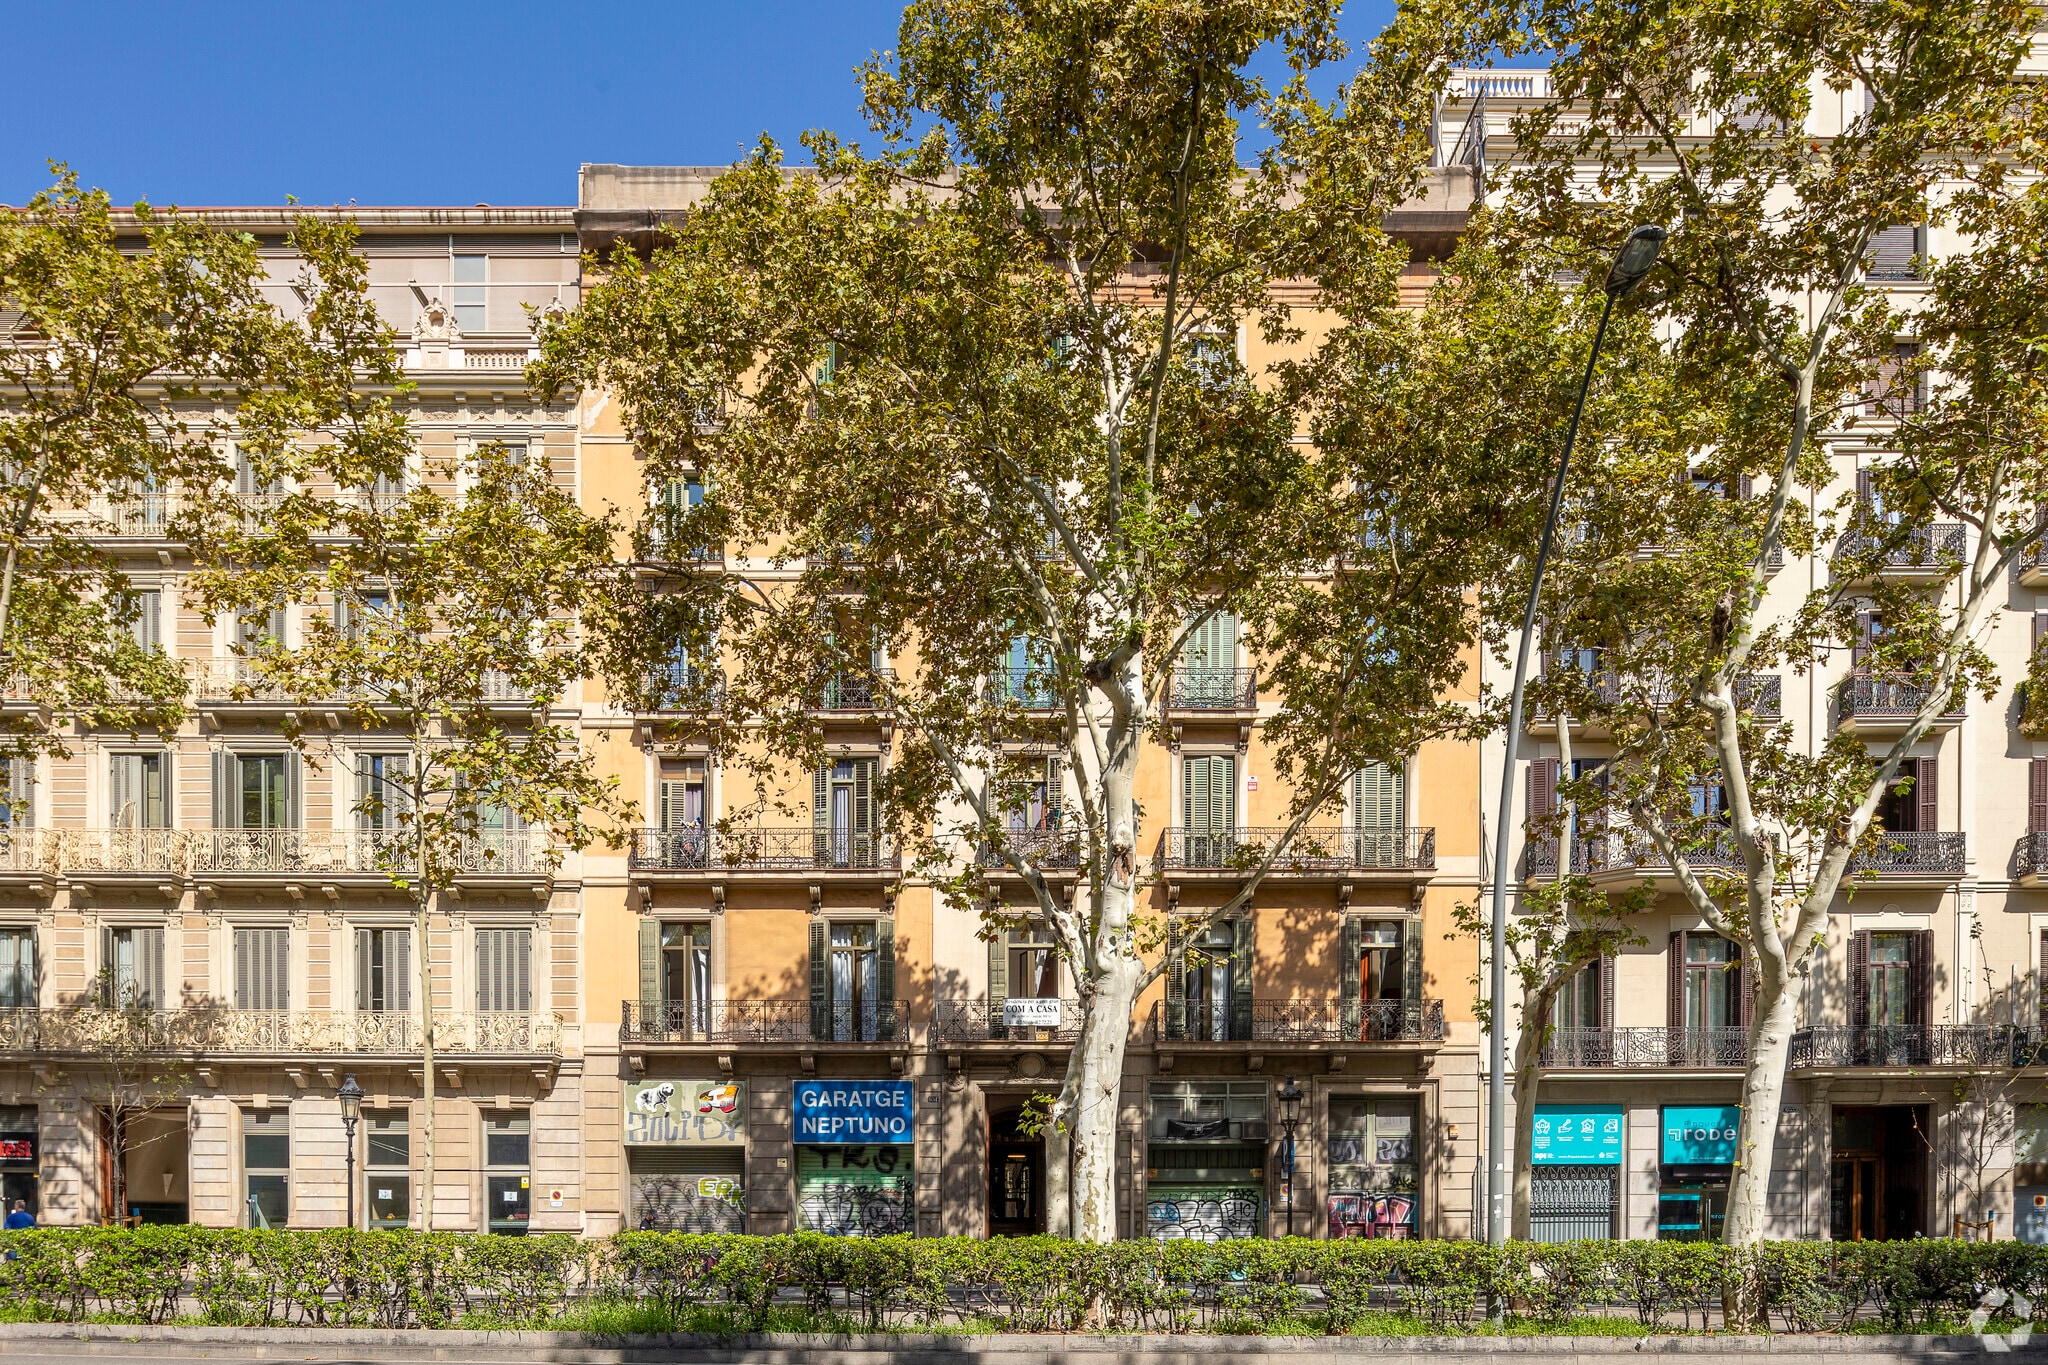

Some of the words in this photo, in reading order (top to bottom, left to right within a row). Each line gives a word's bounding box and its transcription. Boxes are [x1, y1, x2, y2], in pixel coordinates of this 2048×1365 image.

[1005, 1005, 1025, 1013] COM
[1028, 1005, 1034, 1013] A
[1036, 1005, 1058, 1013] CASA
[802, 1090, 905, 1107] GARATGE
[802, 1117, 906, 1134] NEPTUNO
